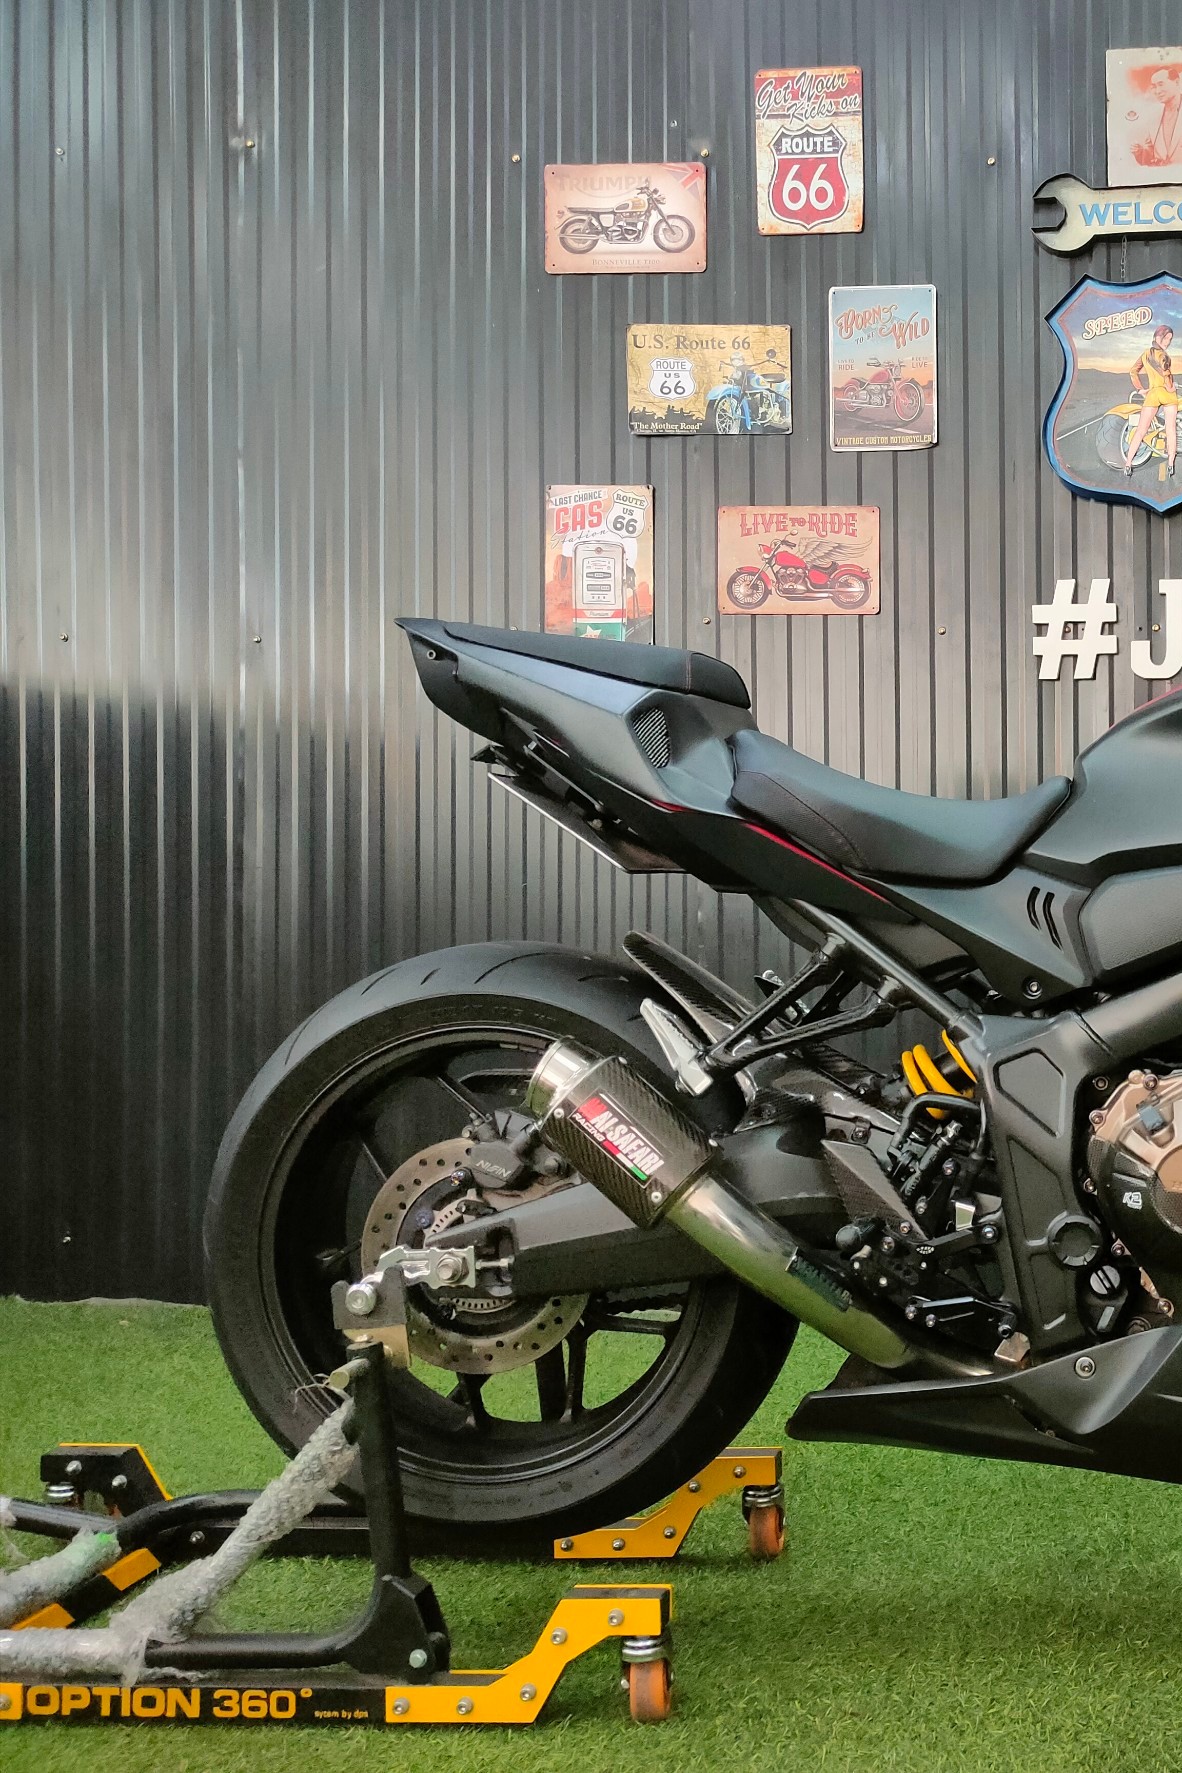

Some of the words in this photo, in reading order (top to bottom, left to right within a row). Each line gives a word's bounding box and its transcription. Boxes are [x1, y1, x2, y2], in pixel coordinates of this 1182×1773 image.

[757, 79, 791, 119] Get
[794, 71, 848, 99] Your
[786, 99, 835, 124] Kicks
[840, 94, 860, 110] on
[781, 137, 833, 153] ROUTE
[557, 174, 653, 192] TRIUMPH
[782, 163, 834, 211] 66
[1082, 306, 1153, 340] SPEED
[632, 334, 669, 350] U.S.
[675, 334, 726, 350] Route
[731, 335, 751, 350] 66
[655, 360, 687, 370] ROUTE
[660, 380, 686, 395] 66
[554, 495, 572, 507] LAST
[574, 489, 602, 505] CHANCE
[615, 493, 646, 508] ROUTE
[555, 500, 603, 534] GAS
[622, 507, 635, 516] US
[612, 515, 638, 535] 66
[740, 512, 788, 537] LIVE
[789, 517, 807, 527] TO
[808, 512, 858, 538] RIDE
[571, 1112, 606, 1142] RACING
[26, 1686, 200, 1718] OPTION
[341, 1709, 352, 1719] by
